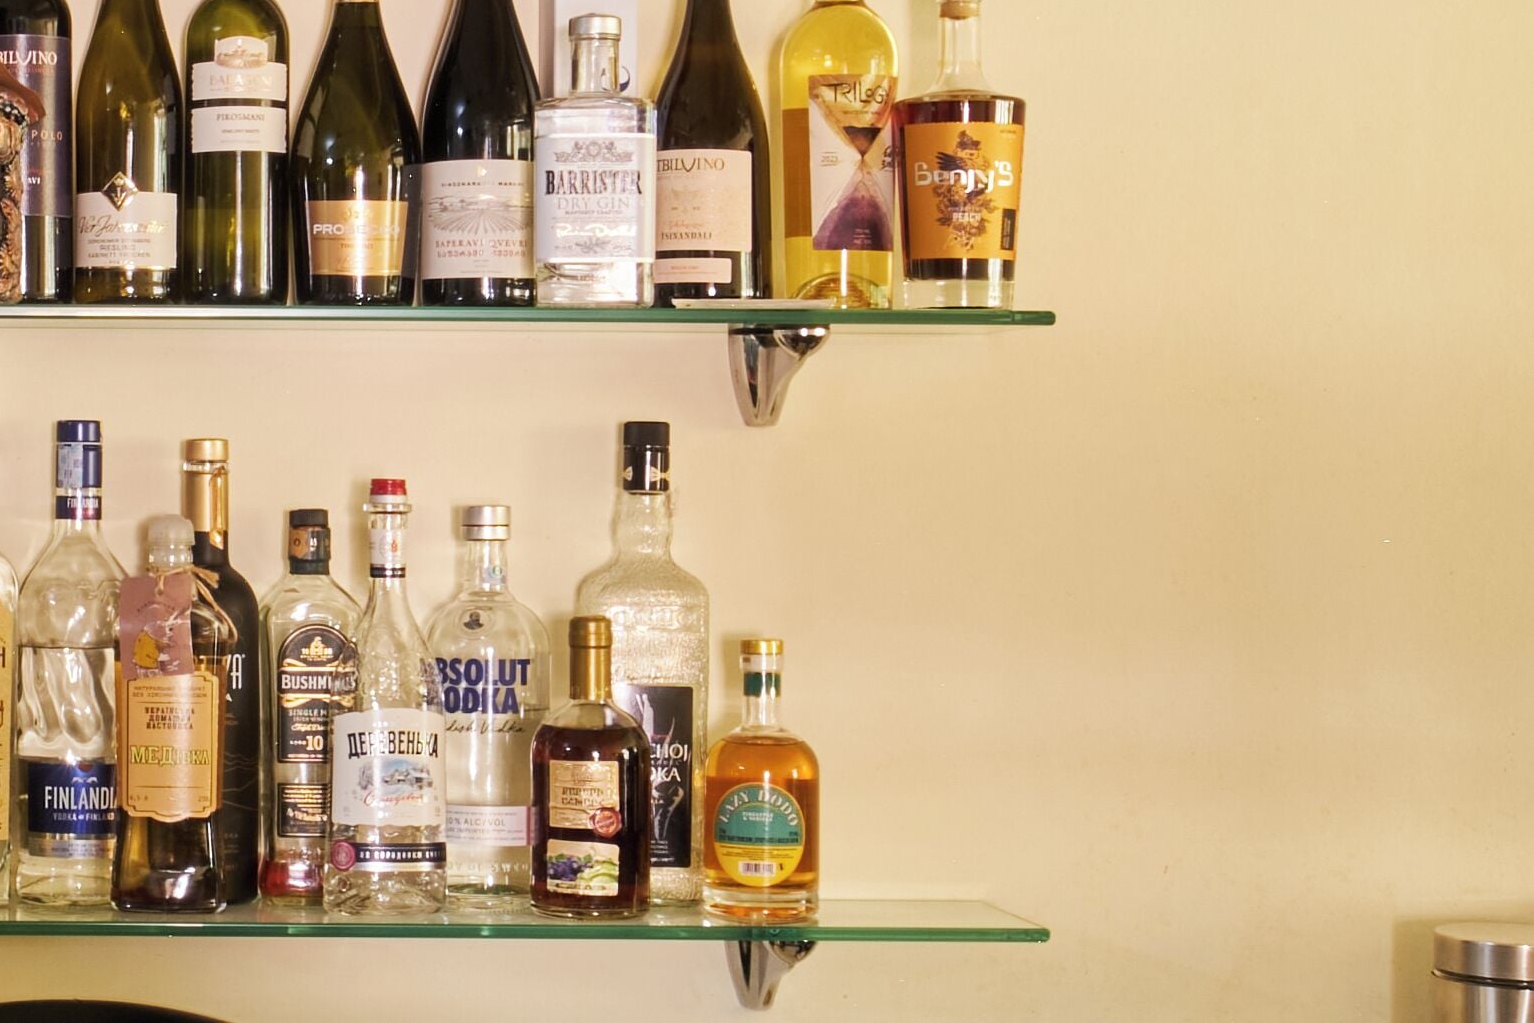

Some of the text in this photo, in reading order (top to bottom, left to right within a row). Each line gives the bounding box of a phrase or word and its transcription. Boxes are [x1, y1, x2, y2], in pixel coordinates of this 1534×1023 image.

[31, 129, 63, 141] POLO
[656, 157, 726, 173] TBILVINO
[544, 169, 643, 196] BARRISTER
[557, 196, 631, 210] DRY GIN
[952, 211, 982, 223] PEACH
[435, 239, 529, 252] SAPERAVI QVEVRI
[66, 497, 99, 509] FINANDIA
[288, 709, 318, 717] SINGLE
[480, 719, 524, 734] Vdka
[306, 735, 324, 751] 10
[348, 731, 439, 759] ДЕРЕВЕНЬКА
[129, 744, 210, 767] МЕДІВКА
[719, 789, 799, 826] LAZY DODO
[52, 812, 77, 821] VODKA
[85, 812, 115, 821] FINLAND
